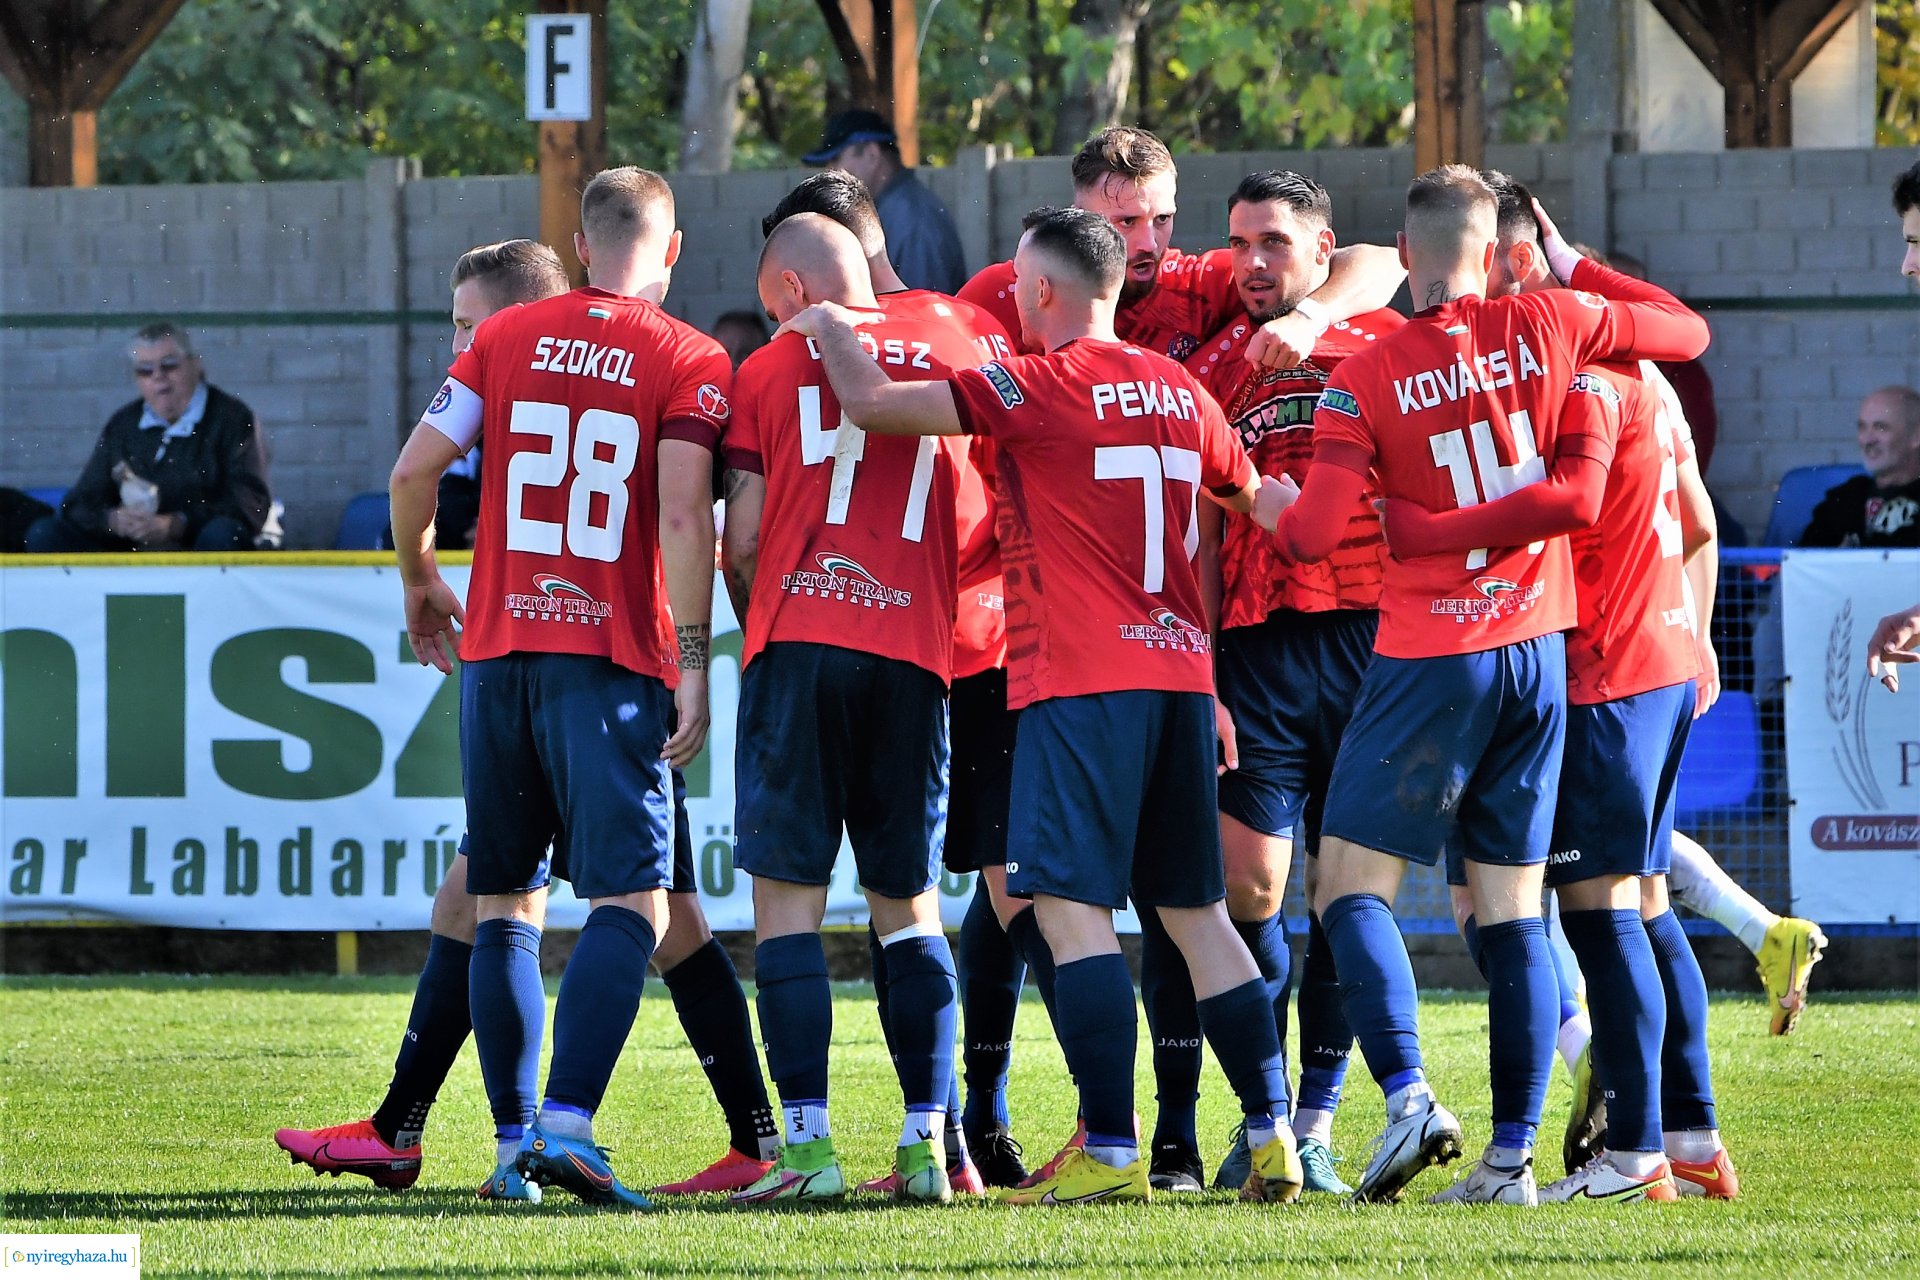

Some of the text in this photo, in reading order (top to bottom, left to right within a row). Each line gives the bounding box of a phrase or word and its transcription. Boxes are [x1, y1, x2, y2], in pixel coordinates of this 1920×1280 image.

[546, 25, 574, 109] F
[530, 336, 636, 388] SZOKOL
[506, 400, 640, 563] 28
[1428, 409, 1548, 571] 14
[1094, 445, 1202, 594] 77
[791, 586, 886, 609] HUNGARY
[850, 579, 911, 607] TRANS
[512, 610, 601, 625] HUNGARY
[1821, 820, 1840, 843] A
[972, 1040, 1012, 1052] JAKO
[1157, 1037, 1199, 1048] JAKO
